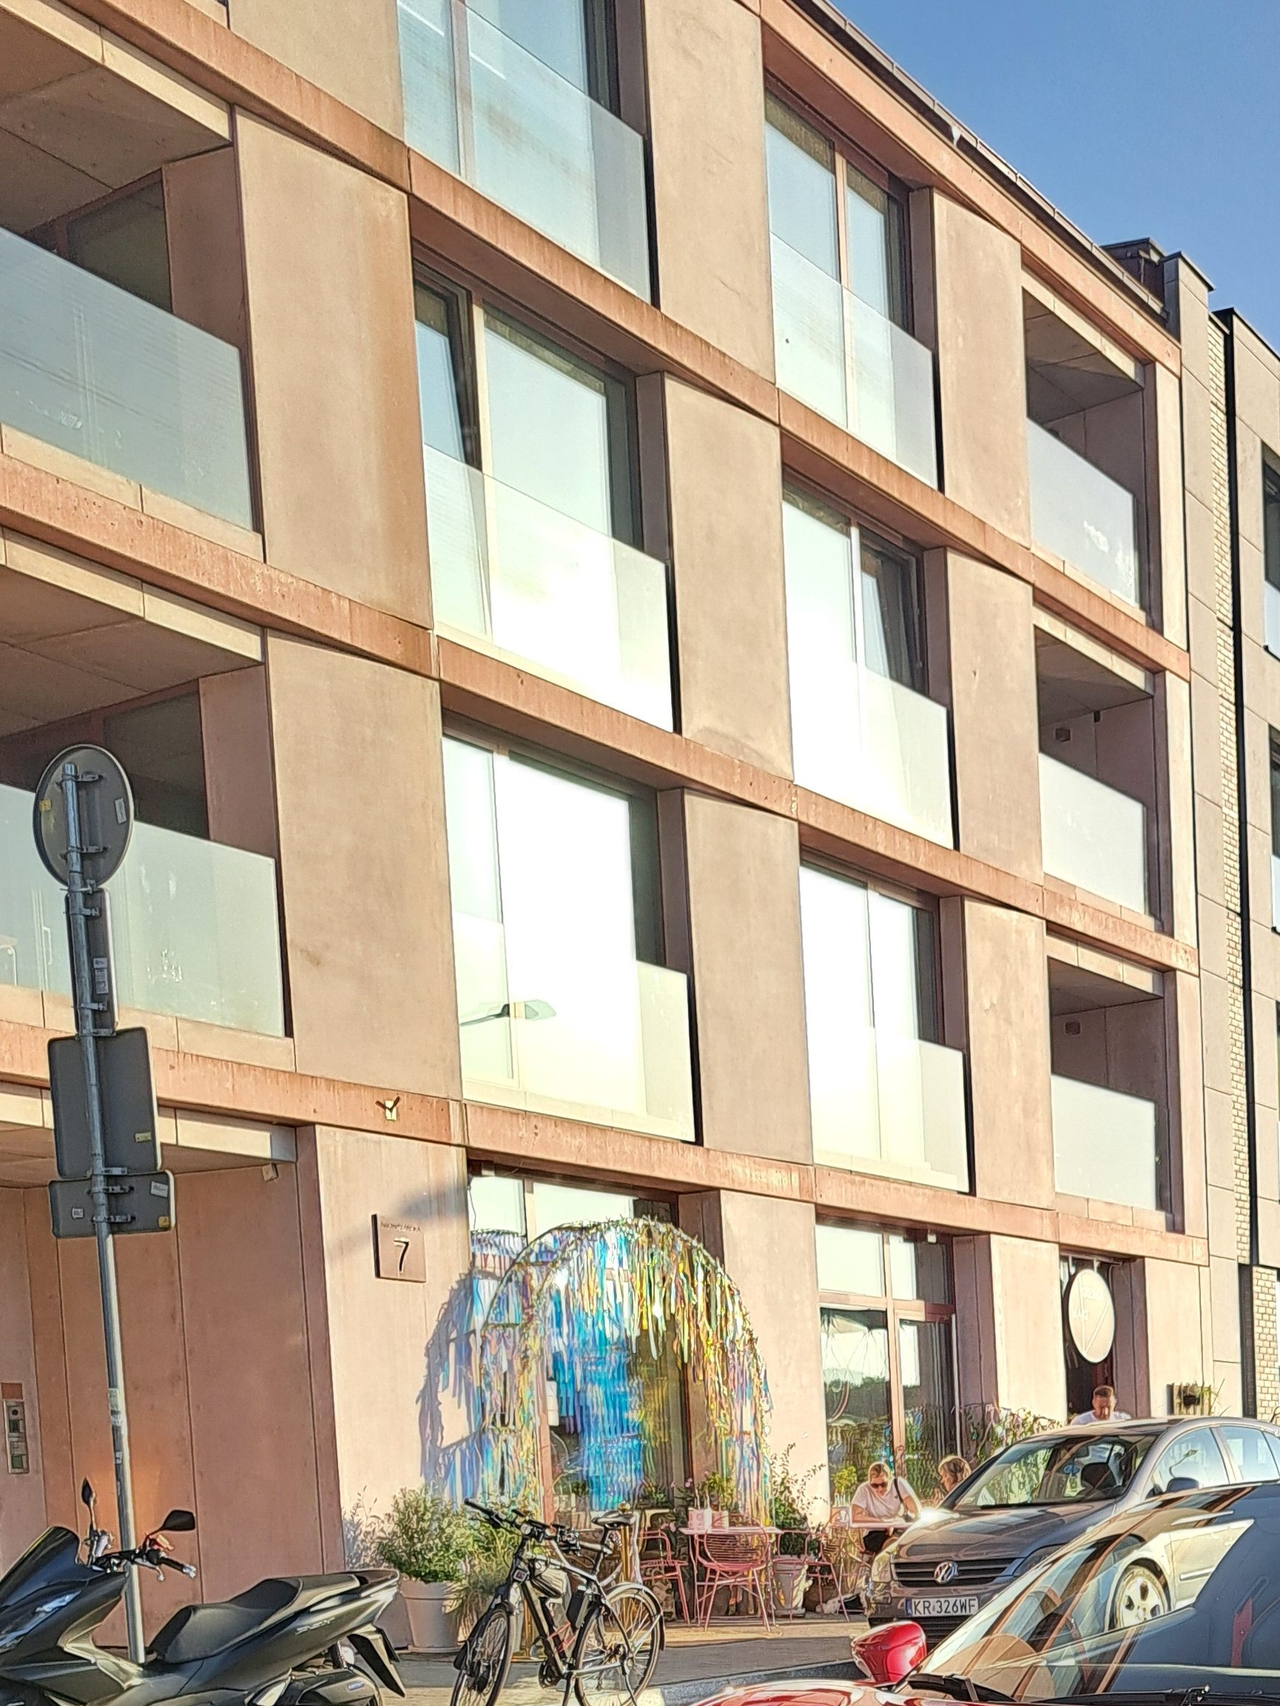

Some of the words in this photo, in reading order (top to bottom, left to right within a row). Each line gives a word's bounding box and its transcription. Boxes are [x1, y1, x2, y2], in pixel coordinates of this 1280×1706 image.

[393, 1237, 410, 1272] 7
[913, 1600, 931, 1615] KR
[935, 1598, 977, 1614] 326WF
